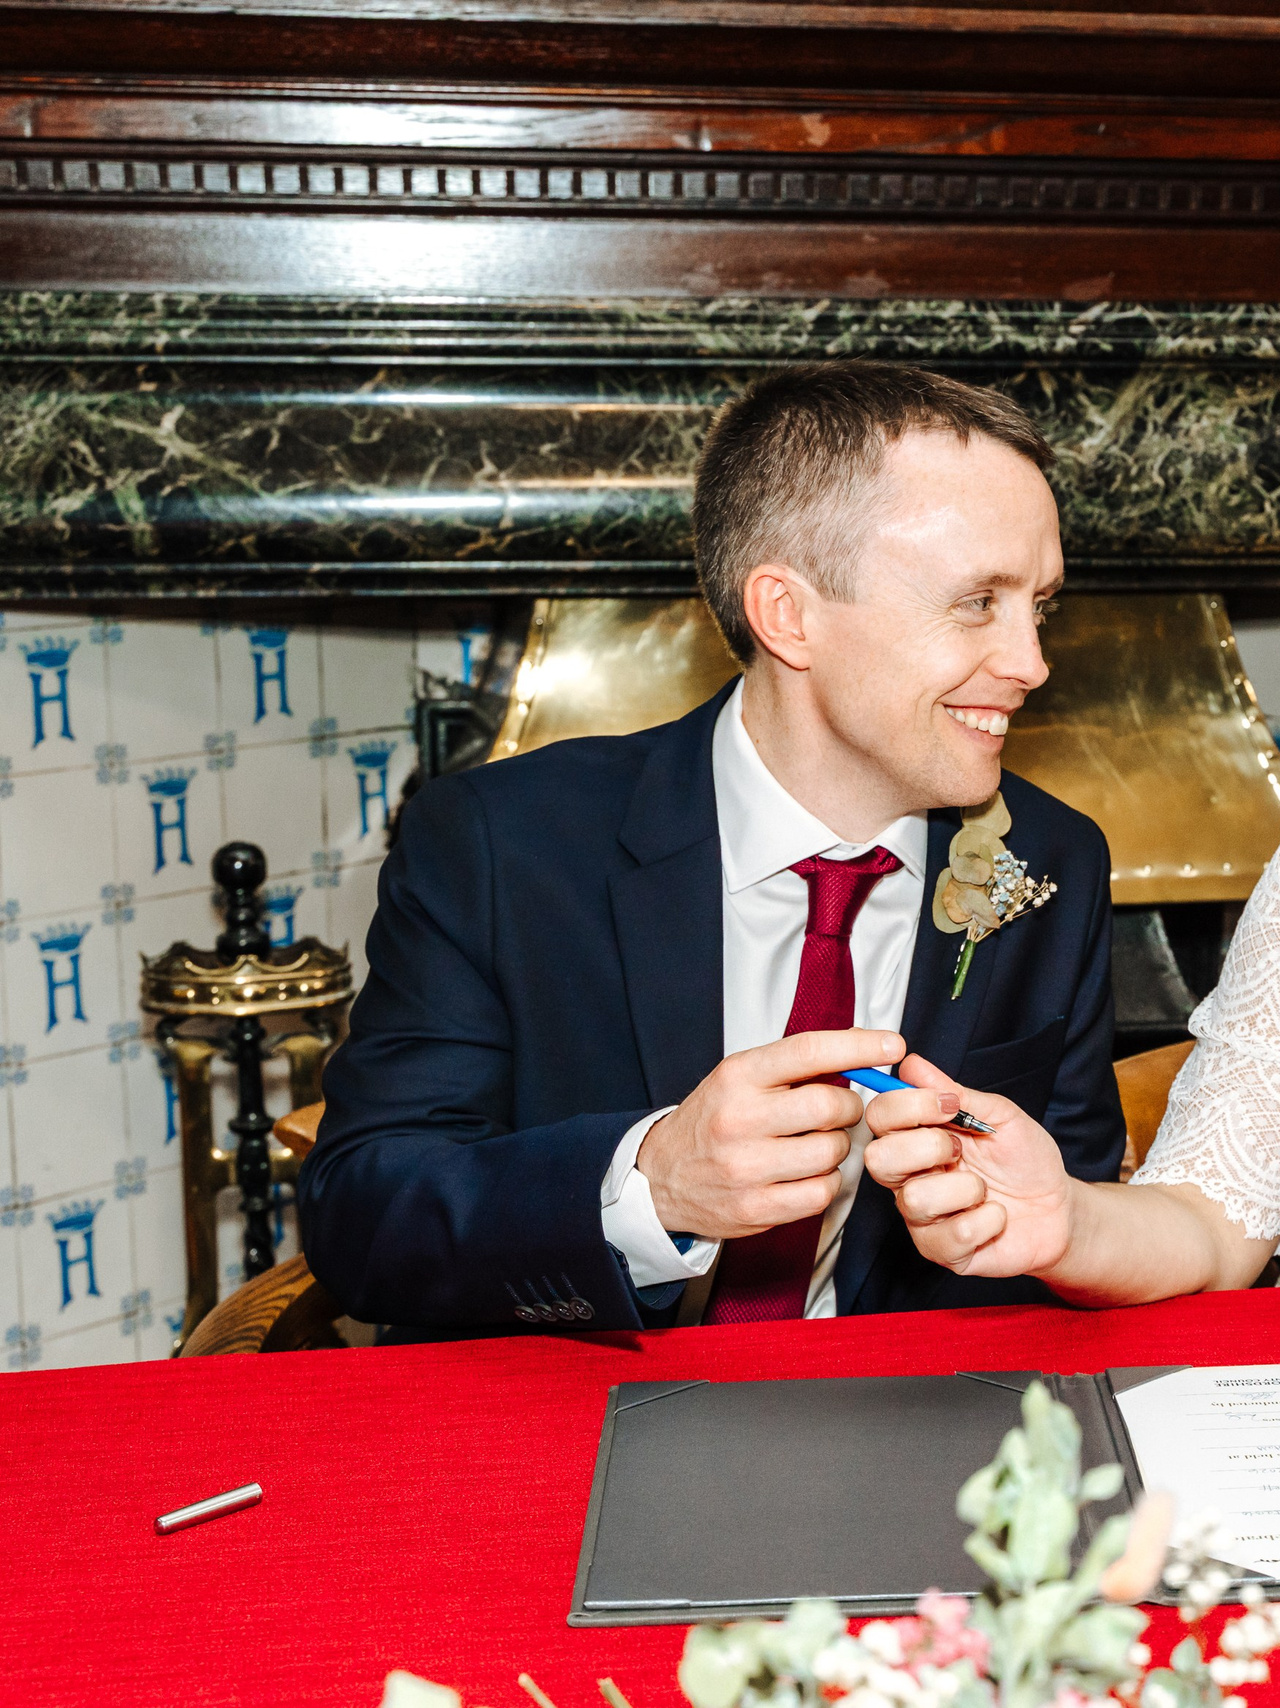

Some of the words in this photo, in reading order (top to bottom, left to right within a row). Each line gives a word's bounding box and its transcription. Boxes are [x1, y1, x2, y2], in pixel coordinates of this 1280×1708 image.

[29, 666, 75, 748] H
[252, 648, 294, 723] H
[150, 793, 194, 874] H
[356, 767, 390, 840] H
[41, 951, 89, 1033] H
[56, 1229, 101, 1310] H
